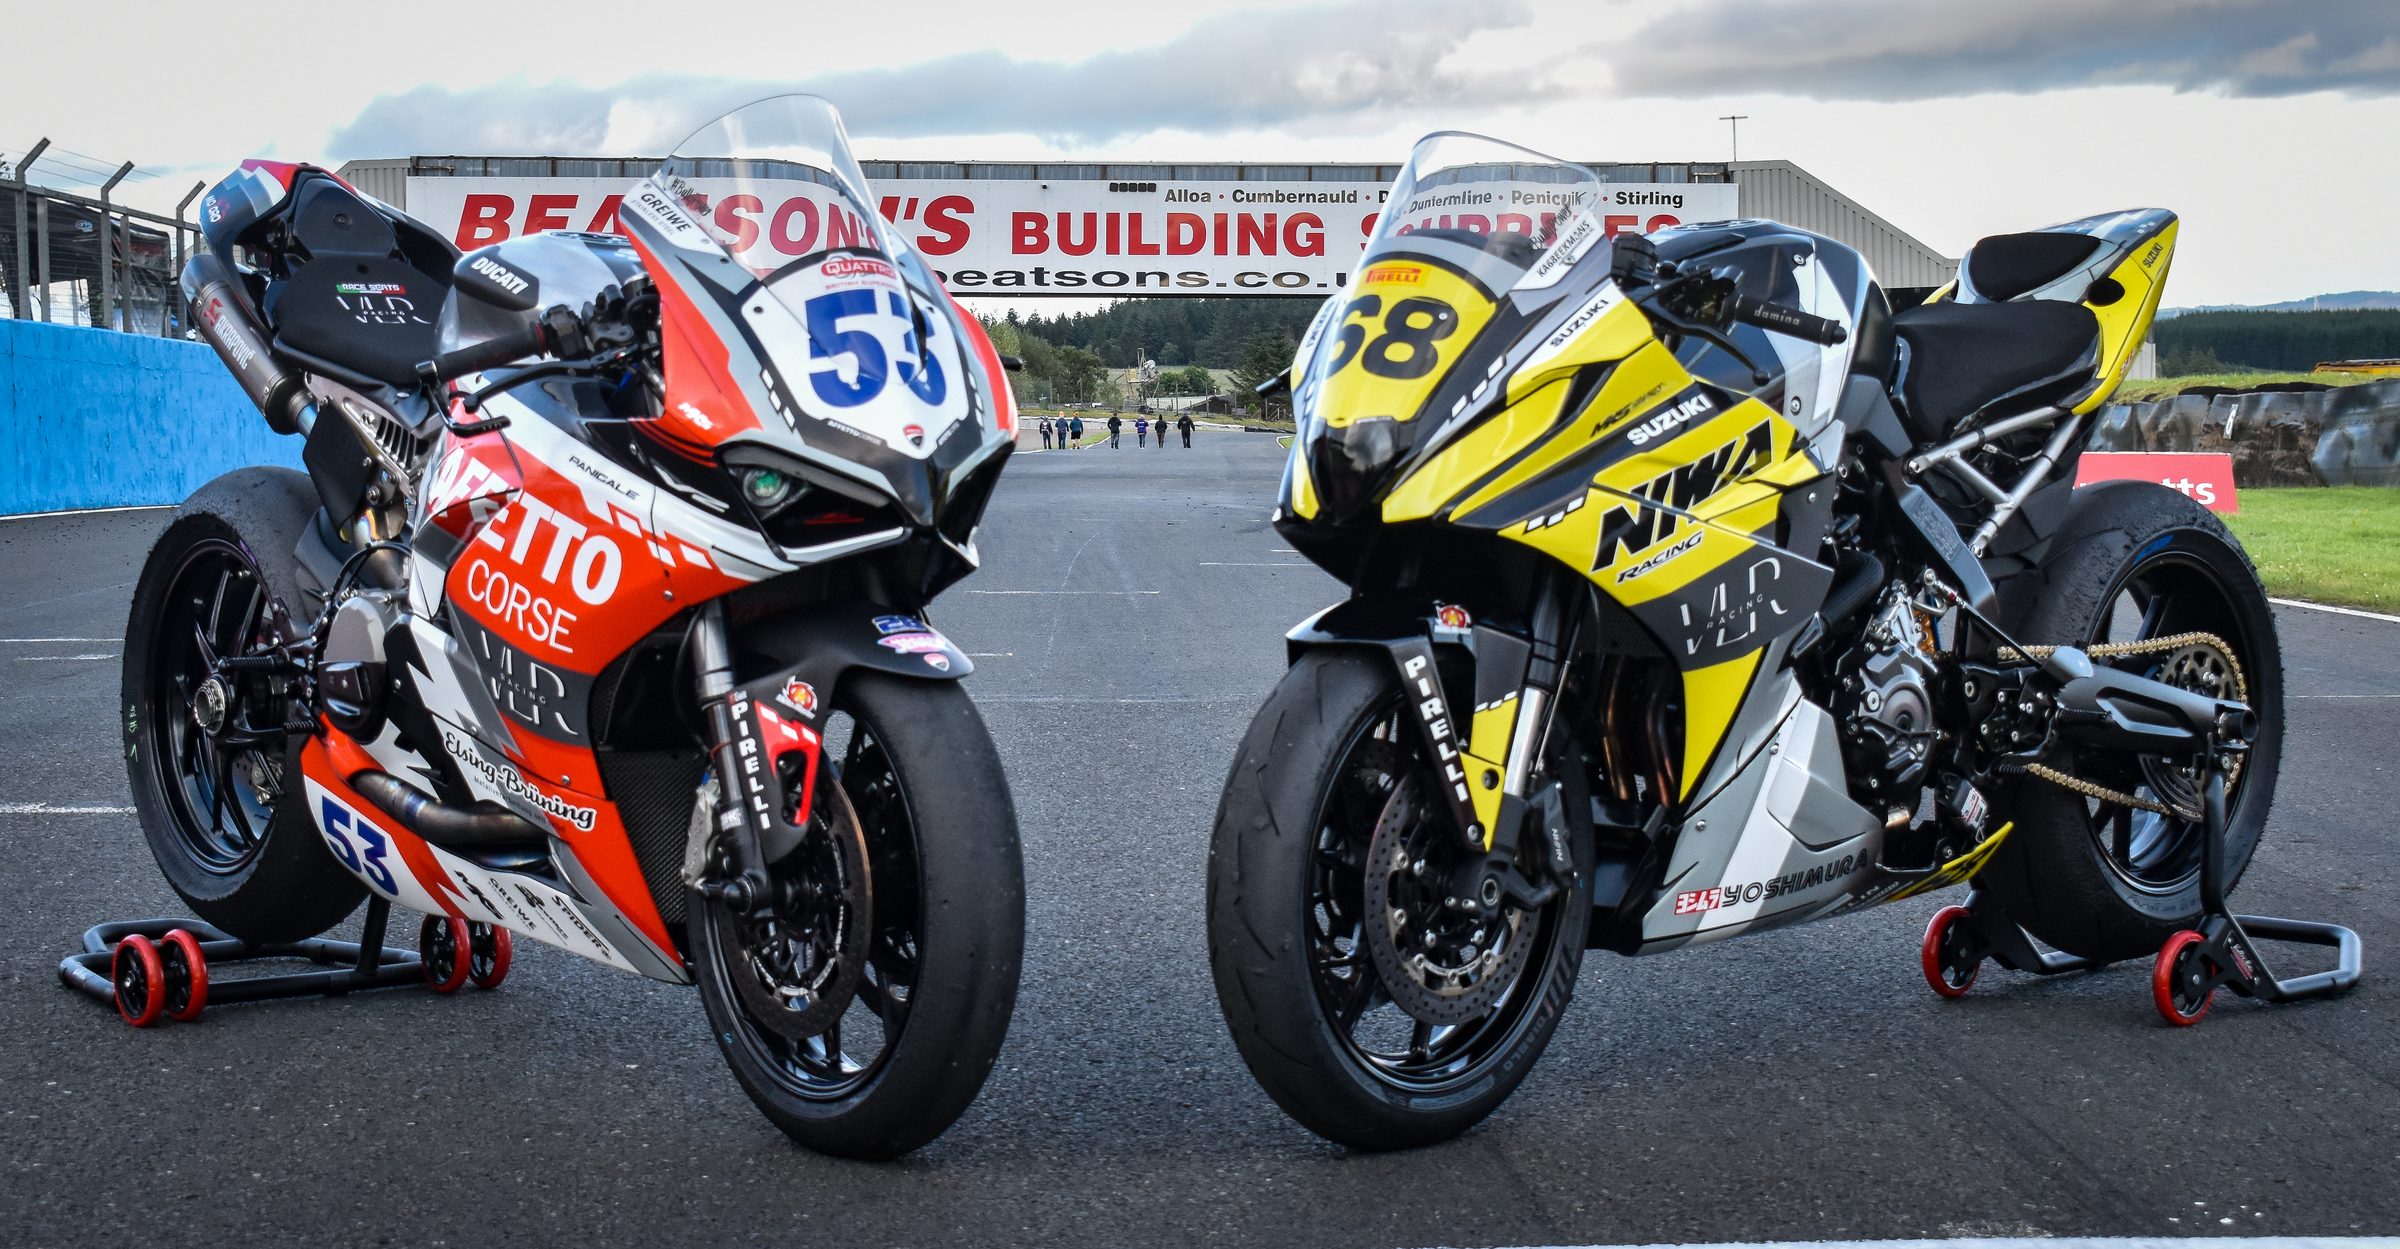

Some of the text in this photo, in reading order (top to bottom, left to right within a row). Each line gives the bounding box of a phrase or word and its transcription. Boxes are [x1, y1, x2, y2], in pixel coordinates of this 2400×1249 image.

[455, 193, 975, 256] BEASON'S
[1012, 211, 1325, 257] BUILDING
[641, 193, 692, 232] GREIWE
[1165, 189, 1211, 203] Alloa
[1232, 189, 1357, 203] Cumbernauld
[1615, 191, 1683, 208] Stirling
[471, 257, 529, 295] DUCATI
[826, 260, 895, 279] QUATTRO
[1365, 267, 1421, 284] PIRELLI
[2142, 242, 2163, 268] SUZUKI
[1327, 294, 1459, 380] 68
[1550, 298, 1609, 347] SUZUKI
[1753, 304, 1800, 325] domino
[806, 289, 949, 408] 53
[1627, 394, 1712, 446] SUZUKI
[569, 456, 640, 500] PANIGALE
[1590, 418, 1773, 572] NIWA
[1616, 531, 1704, 584] RACING
[467, 559, 577, 653] CORSE
[1706, 594, 1763, 629] RACING
[500, 673, 546, 704] RACING
[1404, 654, 1469, 802] PIRELLI
[444, 732, 596, 829] Elsing-Brüning
[731, 701, 771, 829] PIRELLI
[321, 795, 399, 896] 53
[490, 877, 537, 931] GREIWE
[1723, 849, 1868, 907] YOSHIMURA
[551, 895, 604, 953] SPIDER
